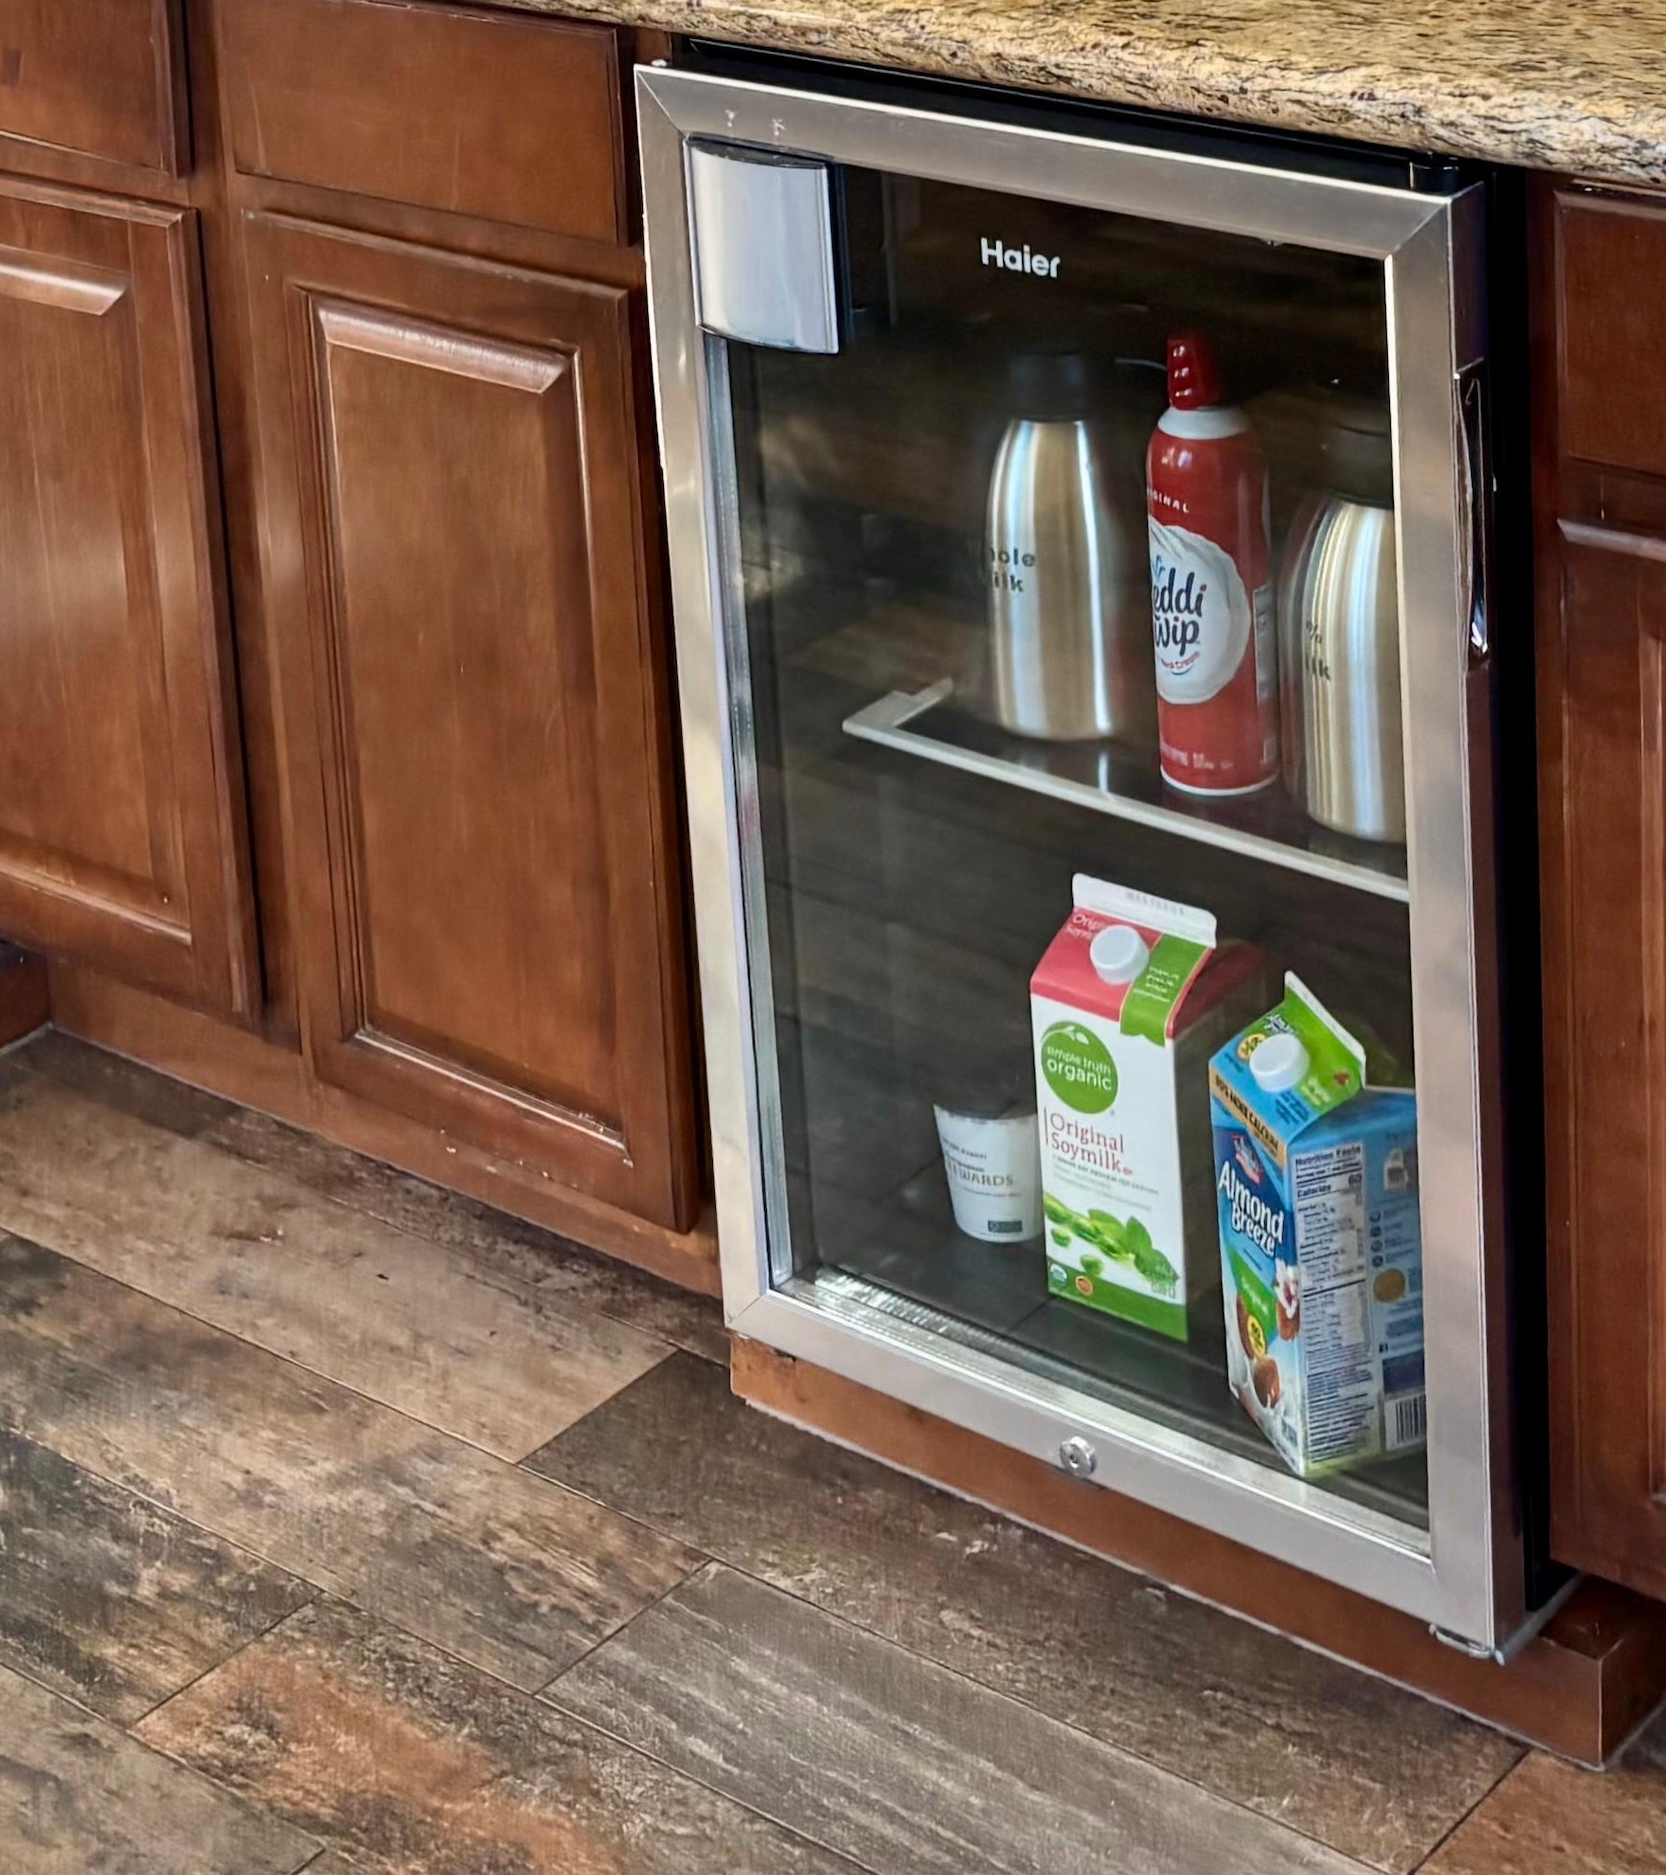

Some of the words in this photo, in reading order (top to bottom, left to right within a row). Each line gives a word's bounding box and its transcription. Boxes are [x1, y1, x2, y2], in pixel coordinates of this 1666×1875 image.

[980, 236, 1061, 278] Haier
[1152, 571, 1207, 619] eddi
[1046, 1059, 1112, 1090] organic
[1047, 1046, 1082, 1065] simple
[1083, 1056, 1111, 1075] truth
[1050, 1112, 1124, 1154] Original
[1051, 1132, 1121, 1174] Soymilk
[1218, 1161, 1285, 1244] Almond
[1231, 1203, 1276, 1257] Breeze
